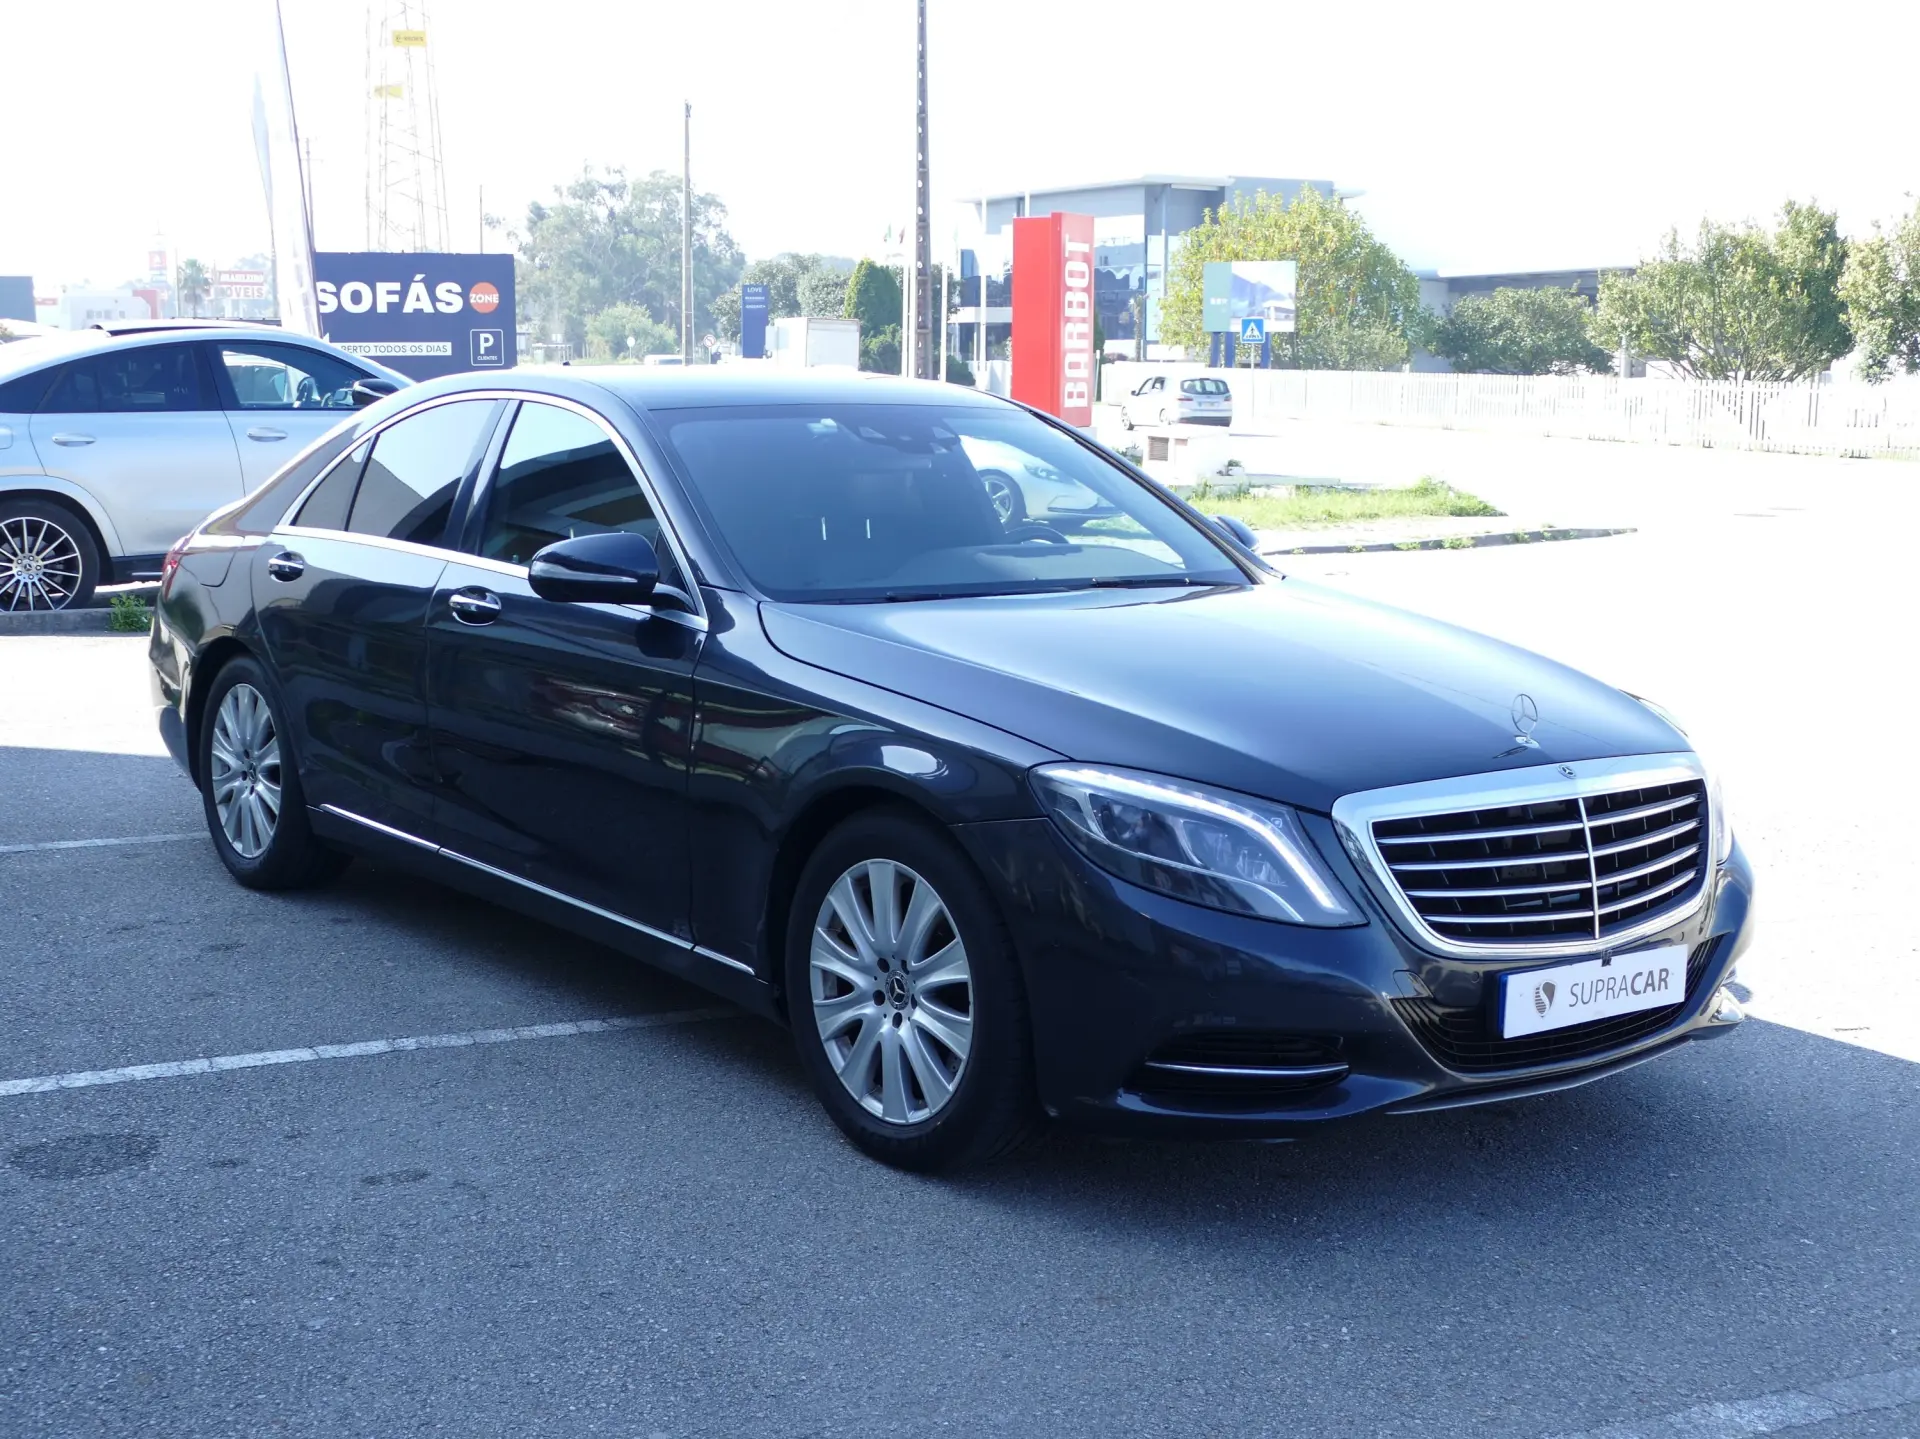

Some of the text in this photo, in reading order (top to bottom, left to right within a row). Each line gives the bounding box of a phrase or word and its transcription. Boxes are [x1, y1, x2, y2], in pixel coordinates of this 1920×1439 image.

[315, 273, 500, 314] SOFÁS ZONE
[1064, 233, 1091, 408] BARBOT
[374, 345, 407, 354] TODOS
[410, 345, 424, 353] OS
[426, 344, 448, 353] DIAS
[479, 333, 495, 355] P
[1569, 968, 1670, 1008] SUPRACAR
